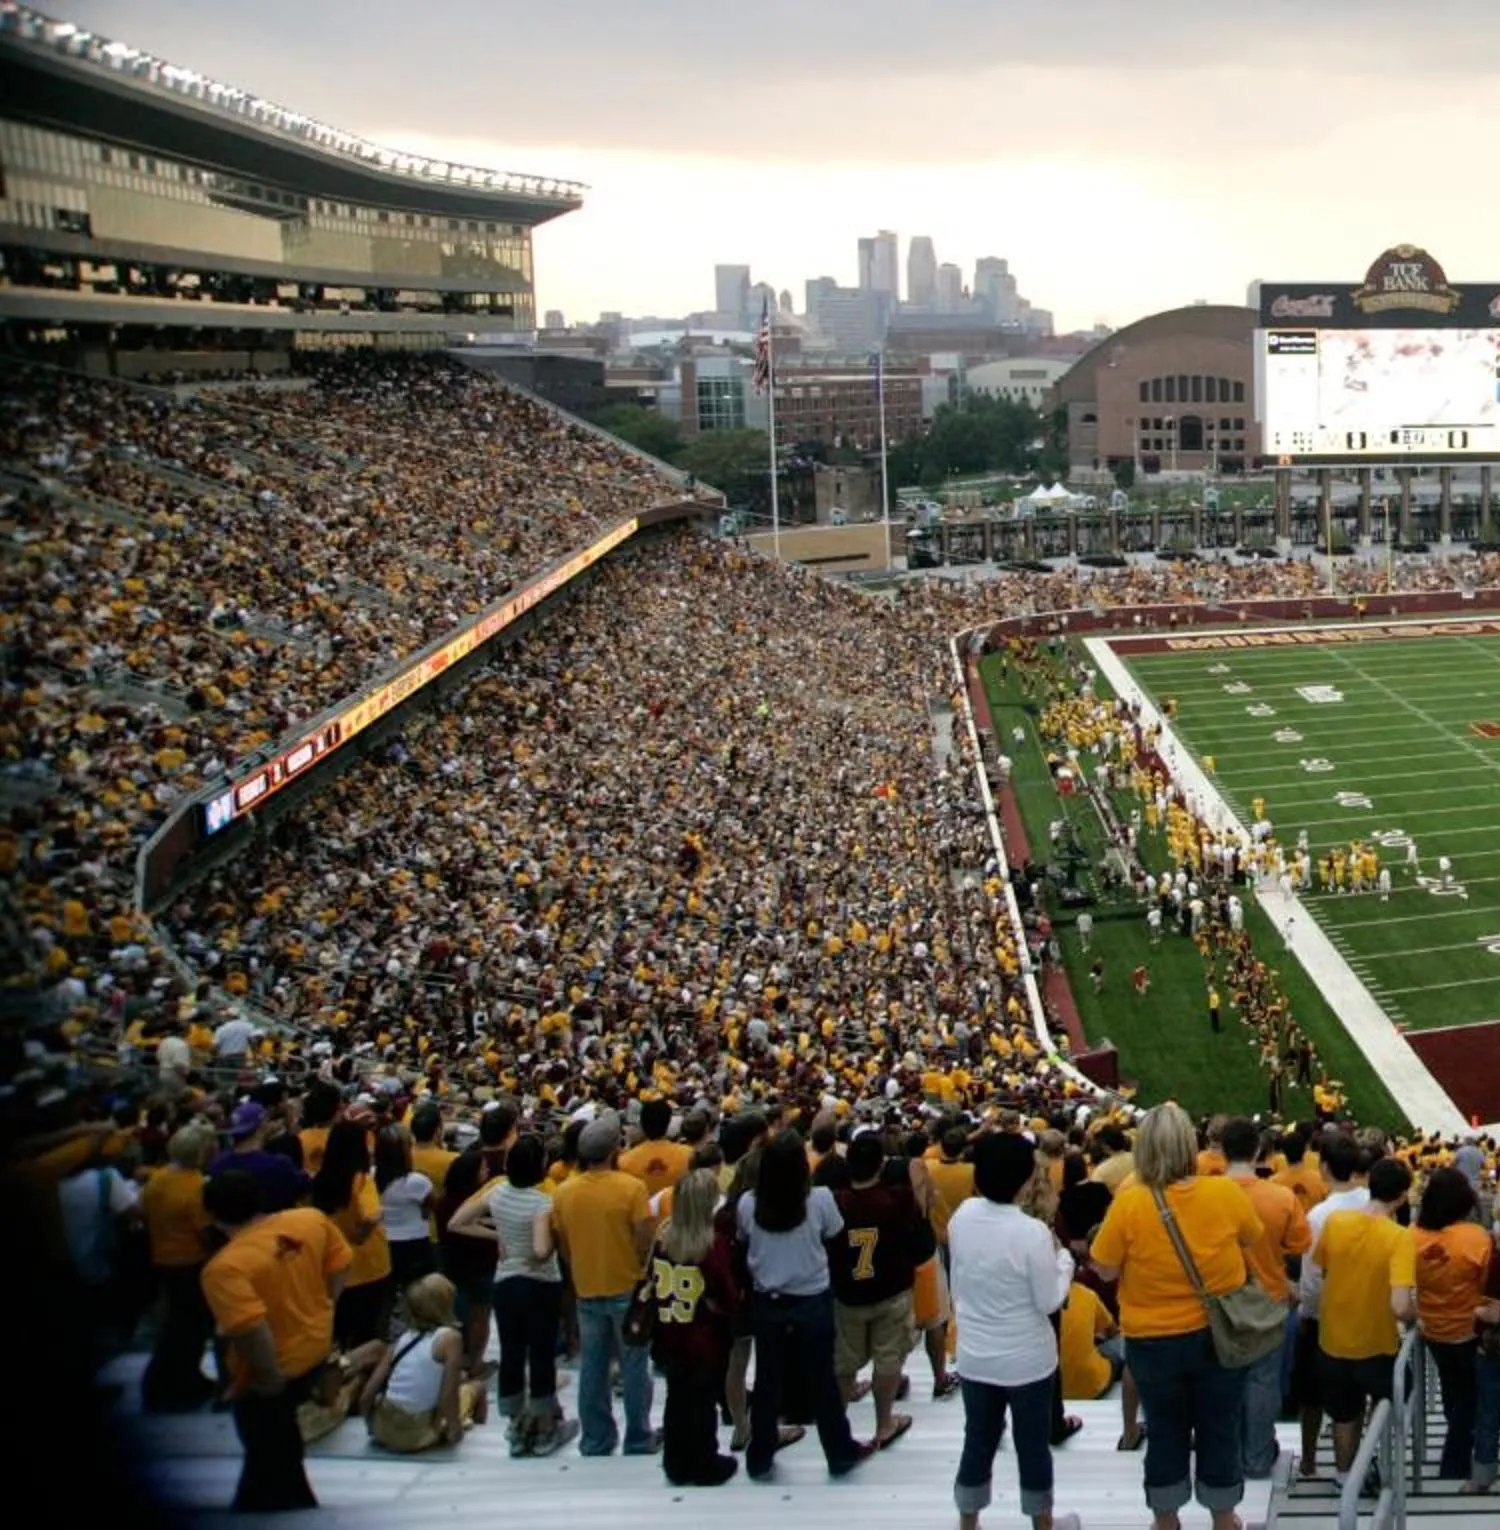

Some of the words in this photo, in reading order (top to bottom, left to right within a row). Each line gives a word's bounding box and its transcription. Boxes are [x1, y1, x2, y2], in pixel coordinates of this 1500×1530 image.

[1389, 263, 1424, 278] TCF
[1383, 276, 1429, 291] BANK
[848, 1227, 879, 1281] 7
